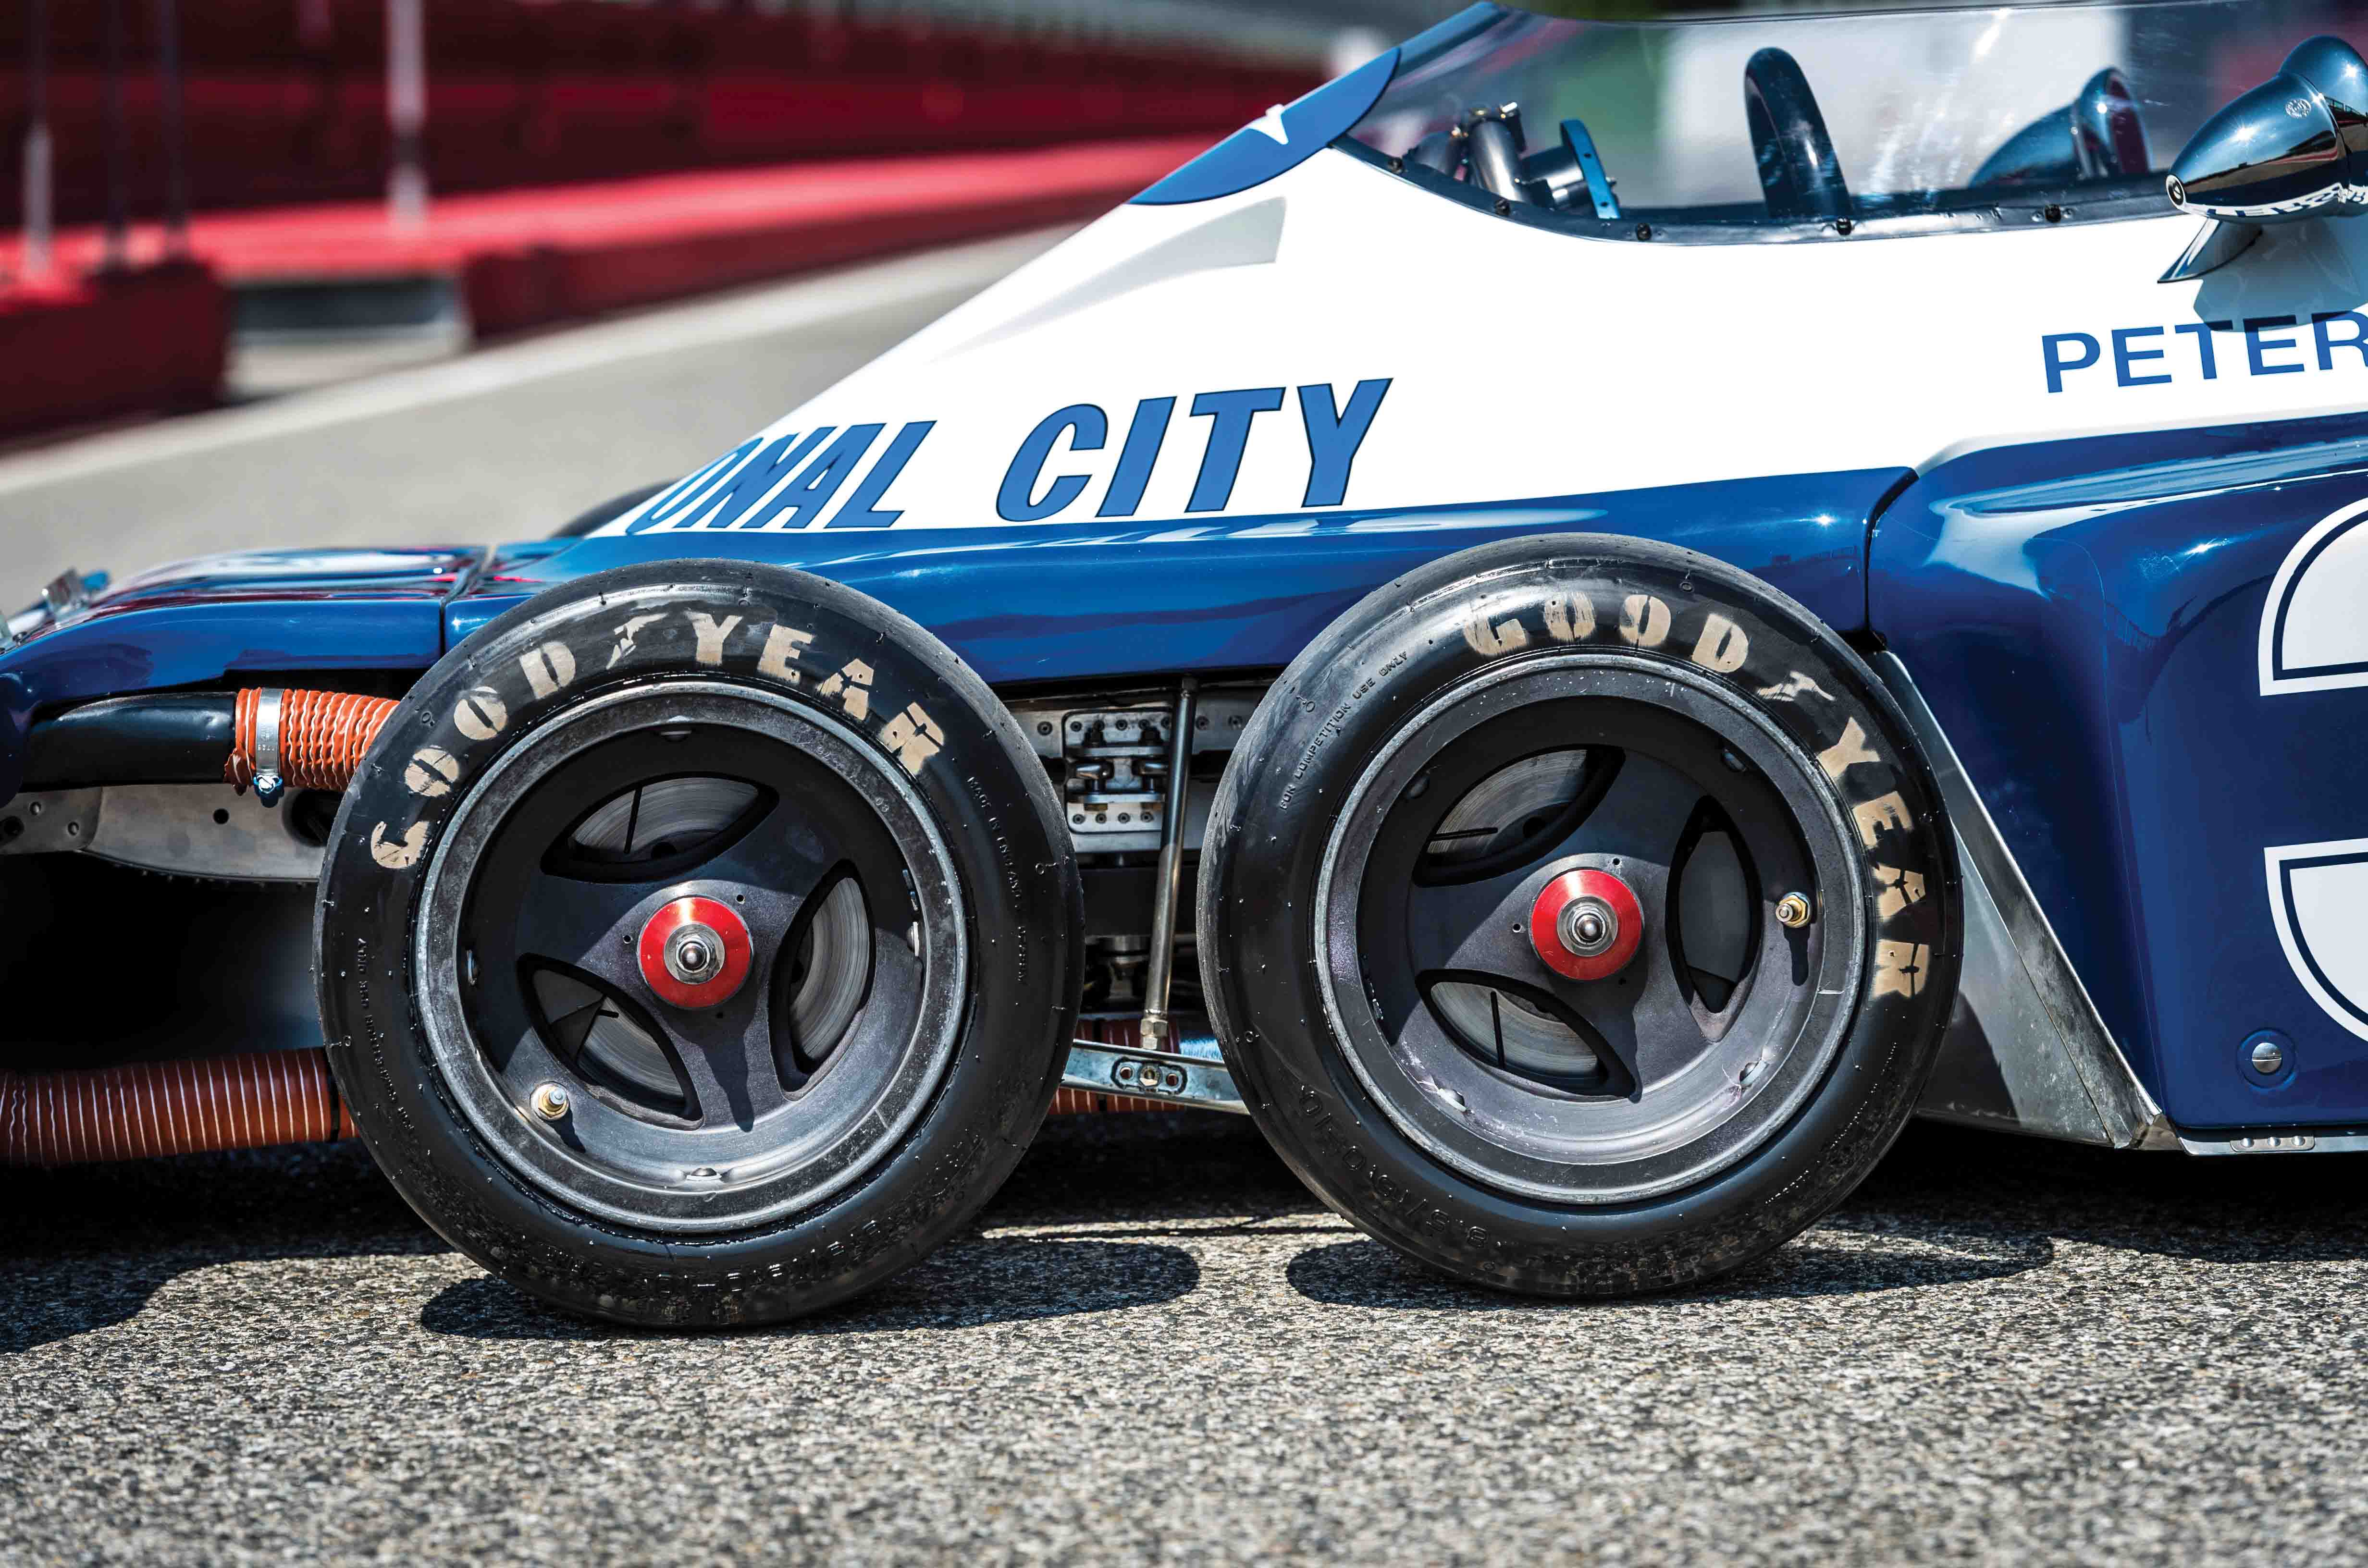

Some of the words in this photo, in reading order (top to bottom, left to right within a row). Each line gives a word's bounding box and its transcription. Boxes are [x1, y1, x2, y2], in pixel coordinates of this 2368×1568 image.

[2042, 310, 2368, 393] PETER
[625, 420, 937, 535] ONAL
[995, 378, 1394, 523] CITY
[371, 641, 576, 869] GOOD
[684, 610, 945, 775] YEAR
[1295, 703, 1351, 780] COMPETITION
[1352, 678, 1376, 700] USE
[1378, 650, 1407, 677] ONLY
[1463, 591, 1750, 673] GOOD
[1817, 717, 1930, 1000] YEAR
